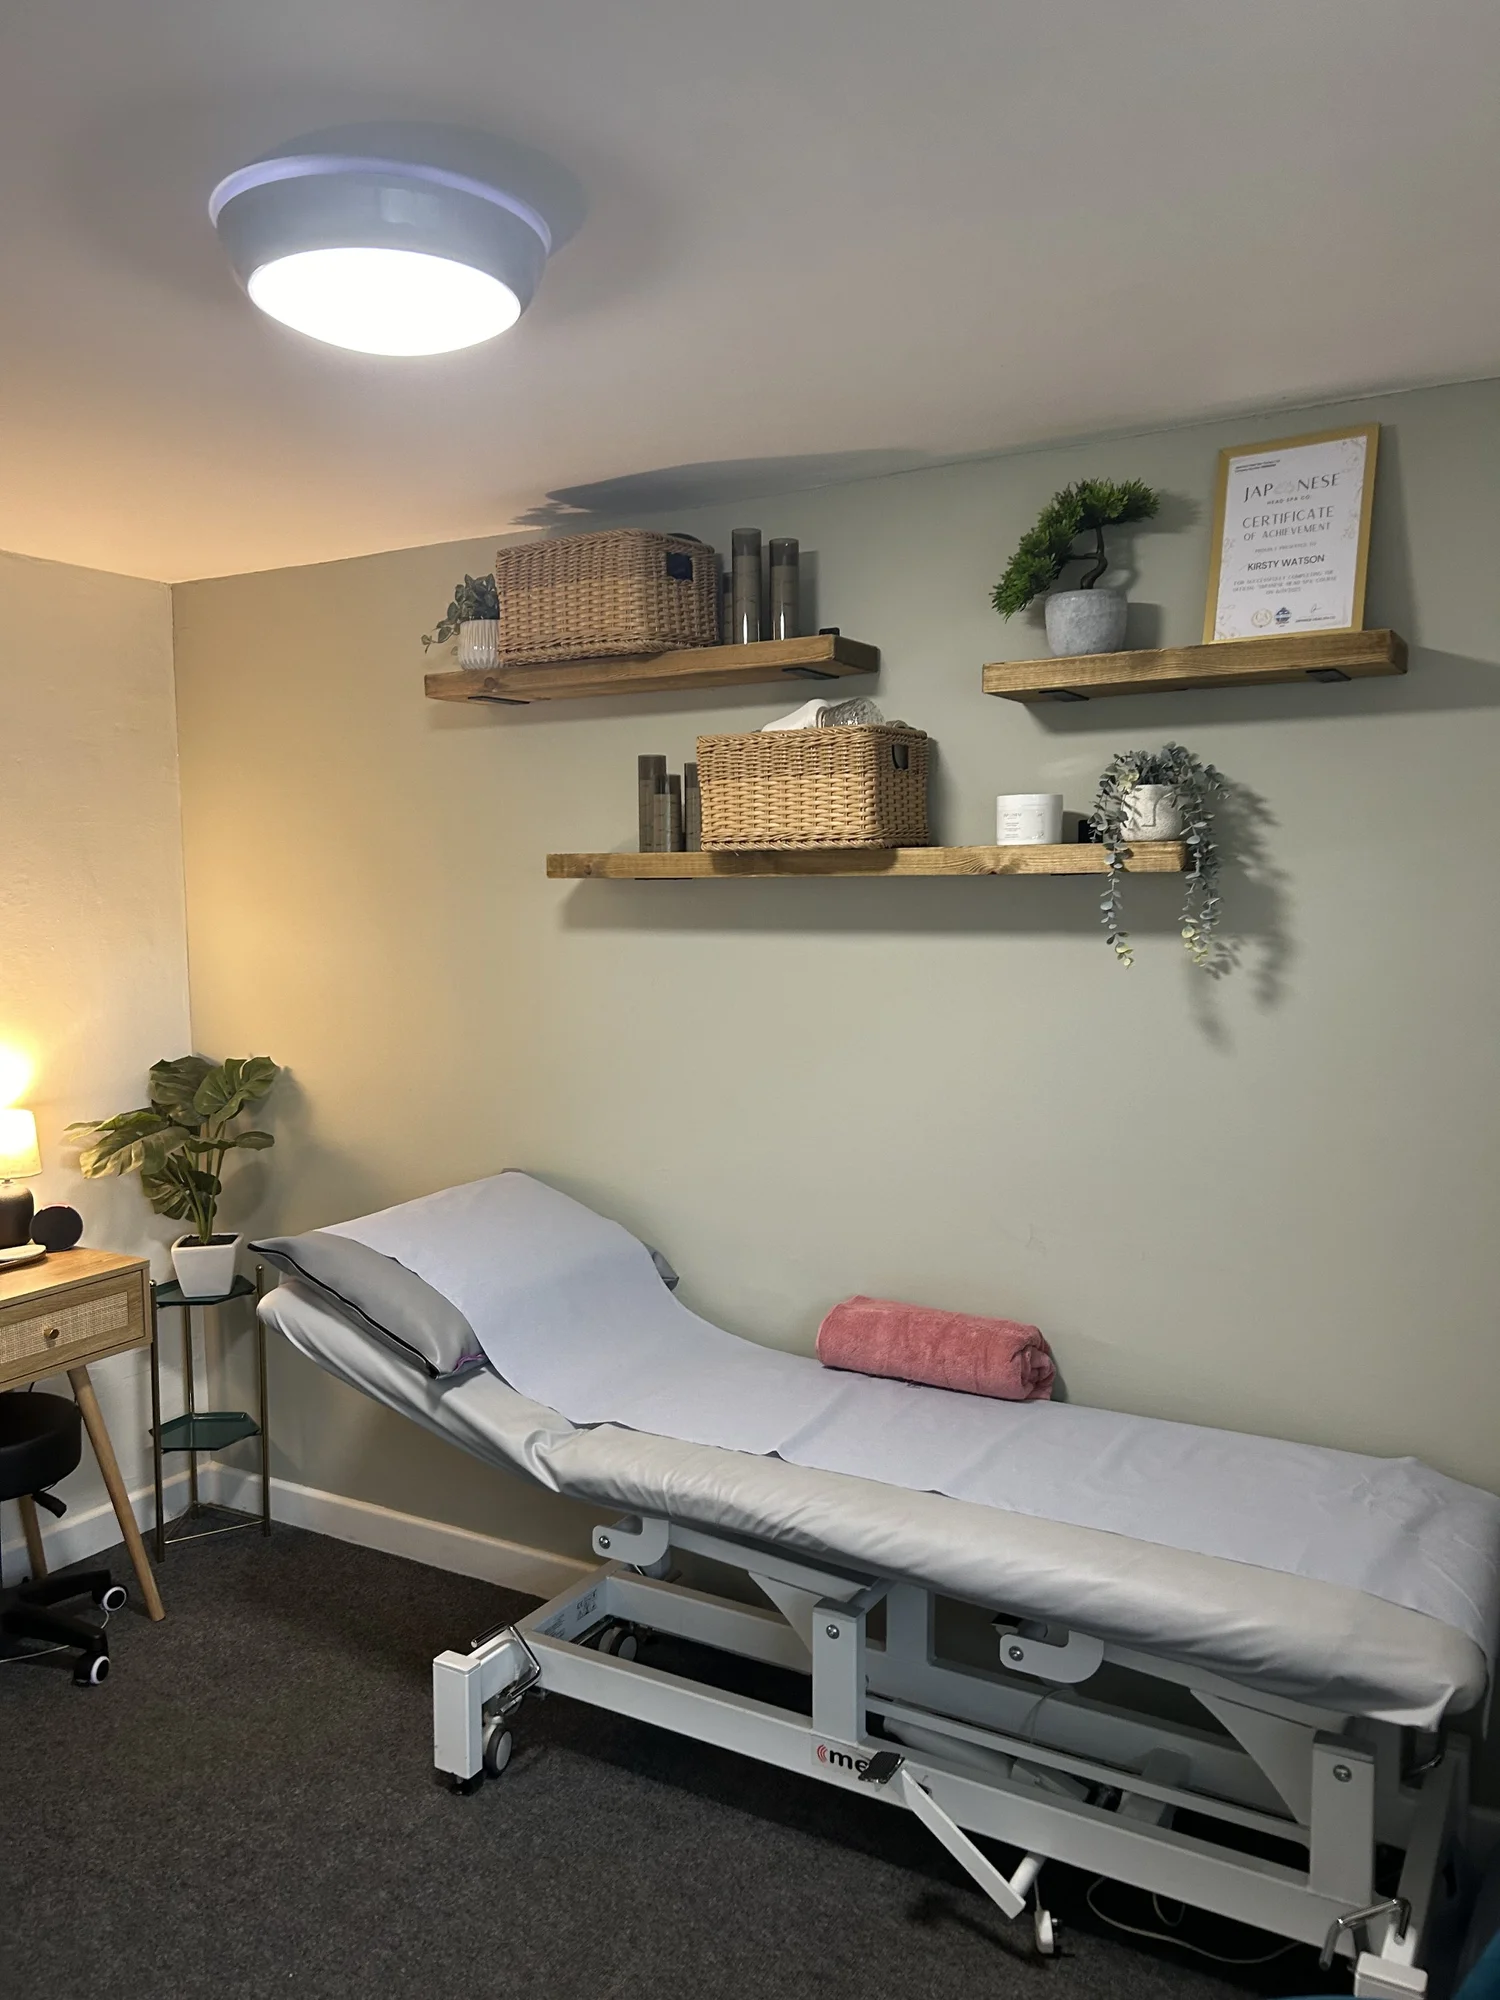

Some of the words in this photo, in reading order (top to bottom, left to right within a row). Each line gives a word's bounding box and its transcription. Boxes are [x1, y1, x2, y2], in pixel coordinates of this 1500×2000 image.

[1242, 505, 1336, 529] CERTIFICATE
[1243, 531, 1257, 541] OF
[1261, 522, 1331, 539] ACHIEVEMENT
[1247, 559, 1280, 571] KIRSTY
[1281, 554, 1325, 567] WATSON
